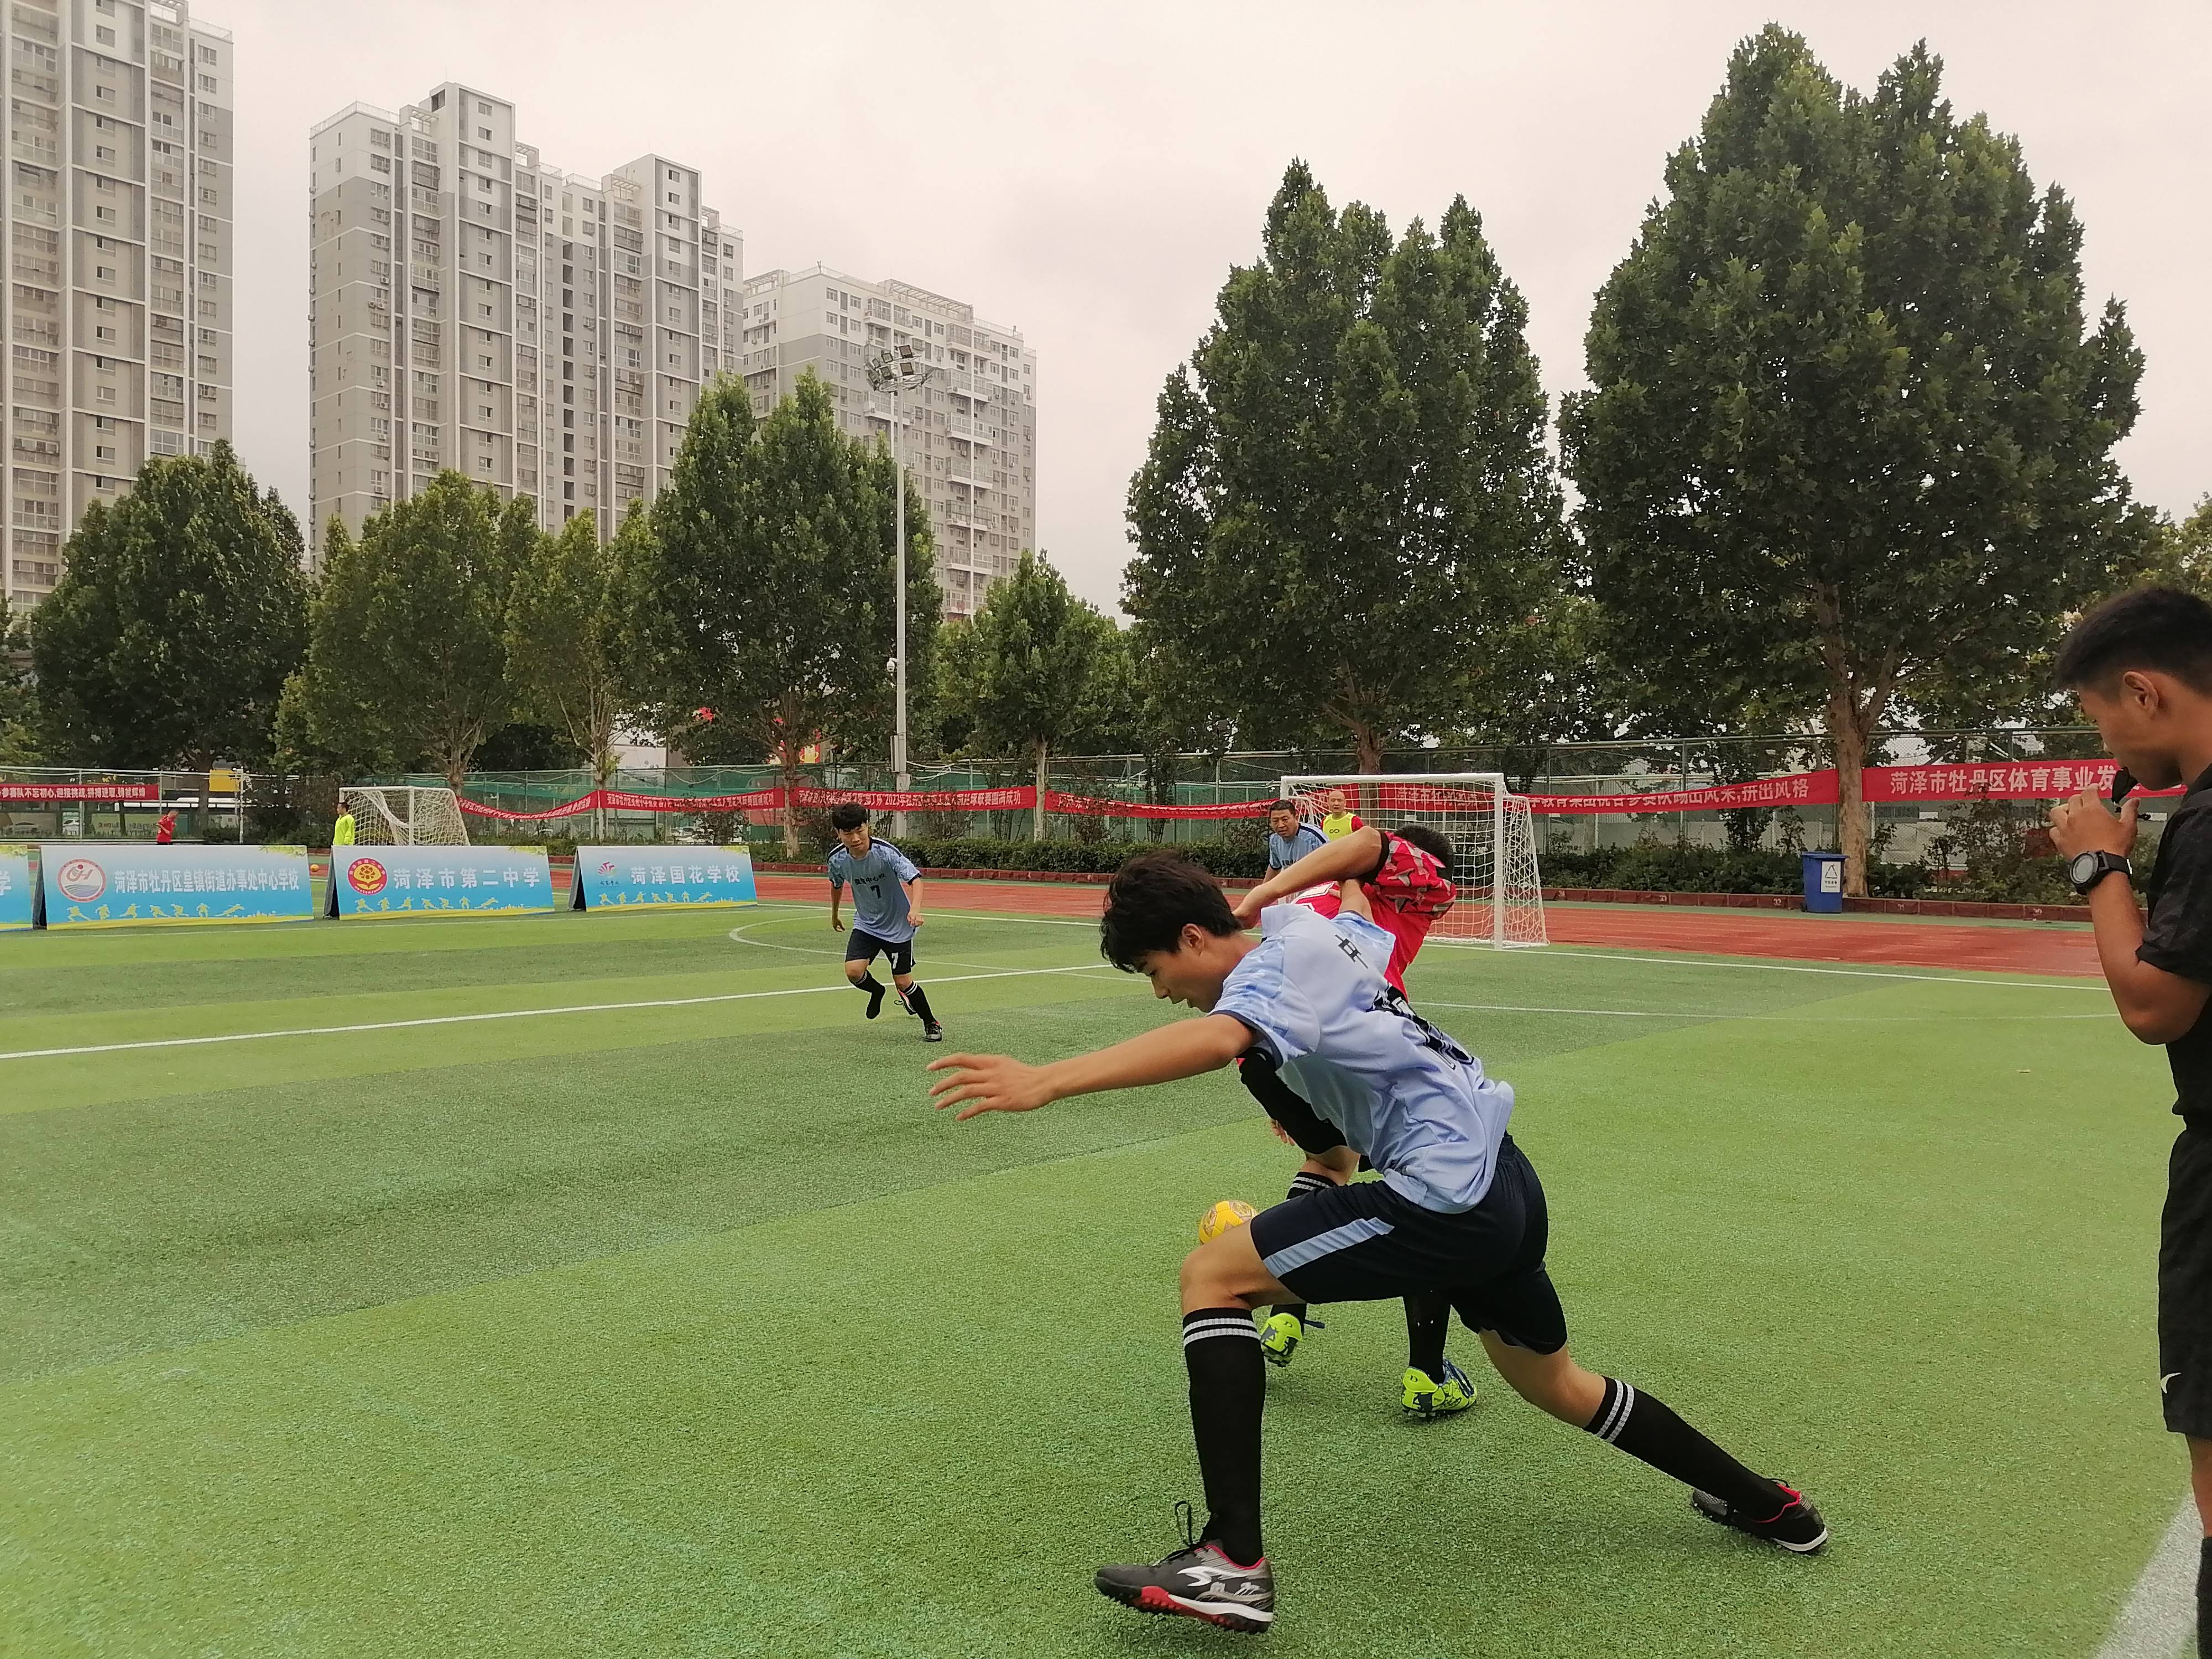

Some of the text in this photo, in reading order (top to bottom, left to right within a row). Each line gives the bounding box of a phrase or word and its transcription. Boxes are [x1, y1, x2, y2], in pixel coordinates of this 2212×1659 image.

[1890, 765, 2140, 794] 菏泽市牡丹区体育事业发
[114, 868, 299, 894] 菏泽市牡丹区皇镇街道办事处中心学校
[393, 867, 540, 890] 菏泽市第二中学
[630, 864, 741, 885] 菏泽国花学校
[870, 884, 881, 899] 7
[891, 952, 899, 969] 7
